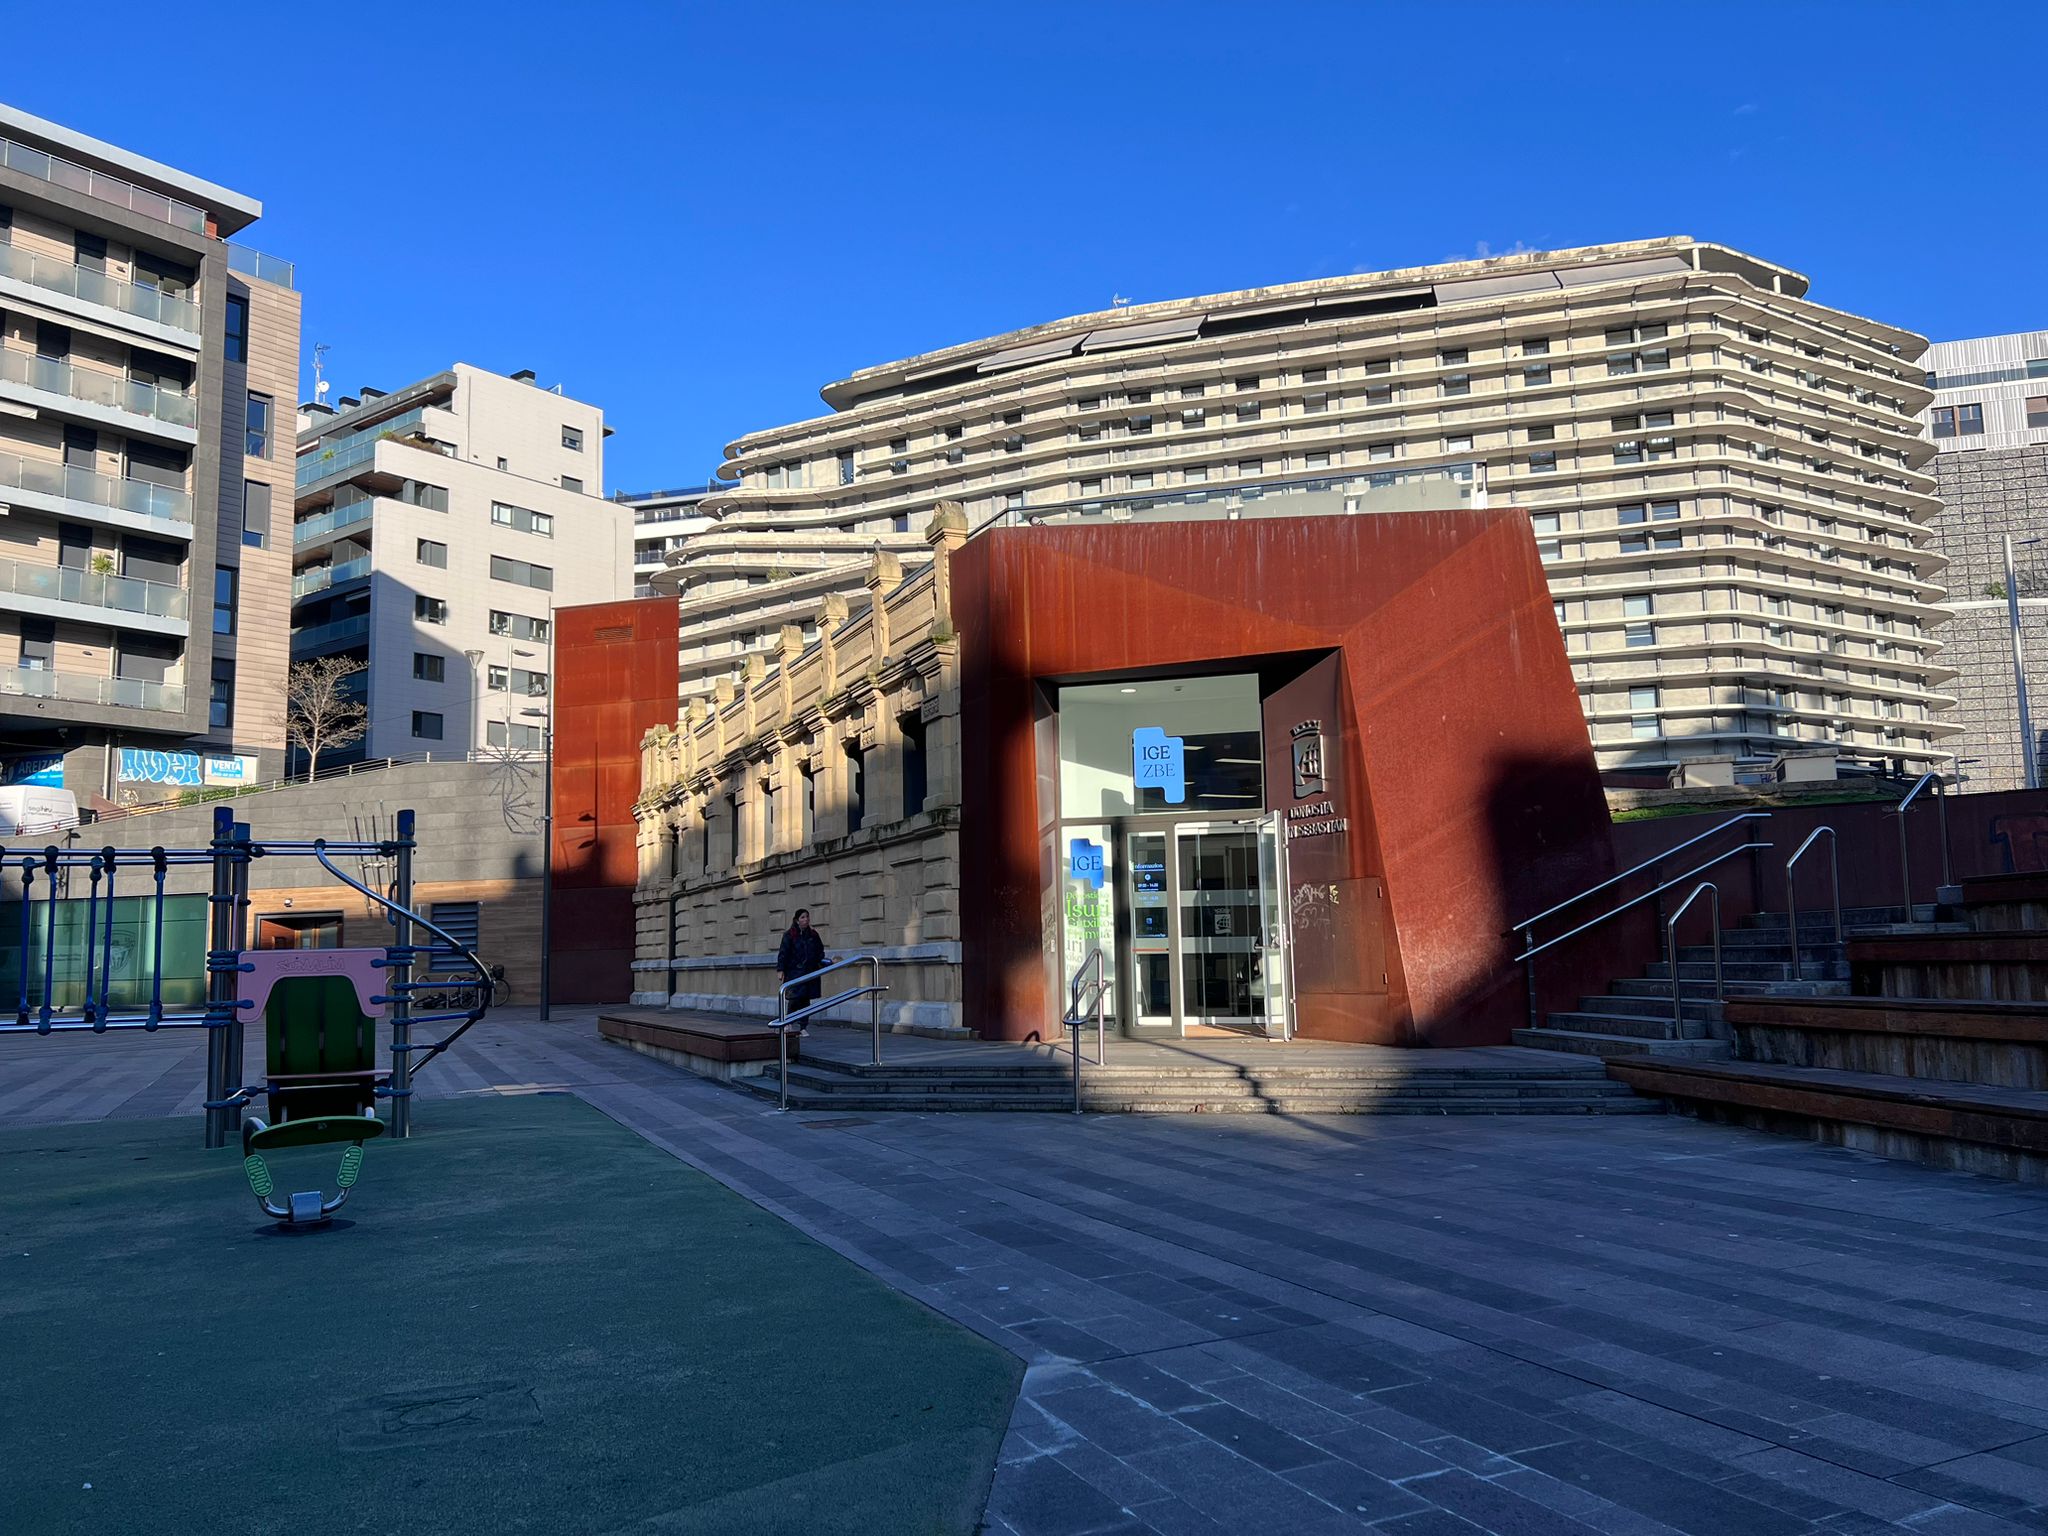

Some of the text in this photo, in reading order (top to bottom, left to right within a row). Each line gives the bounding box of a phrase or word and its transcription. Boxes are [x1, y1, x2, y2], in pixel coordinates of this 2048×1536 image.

[1143, 745, 1171, 760] IGE
[213, 761, 241, 770] VENTA
[1143, 763, 1176, 778] ZBE
[1072, 855, 1102, 871] IGE
[1067, 899, 1109, 918] Isuri
